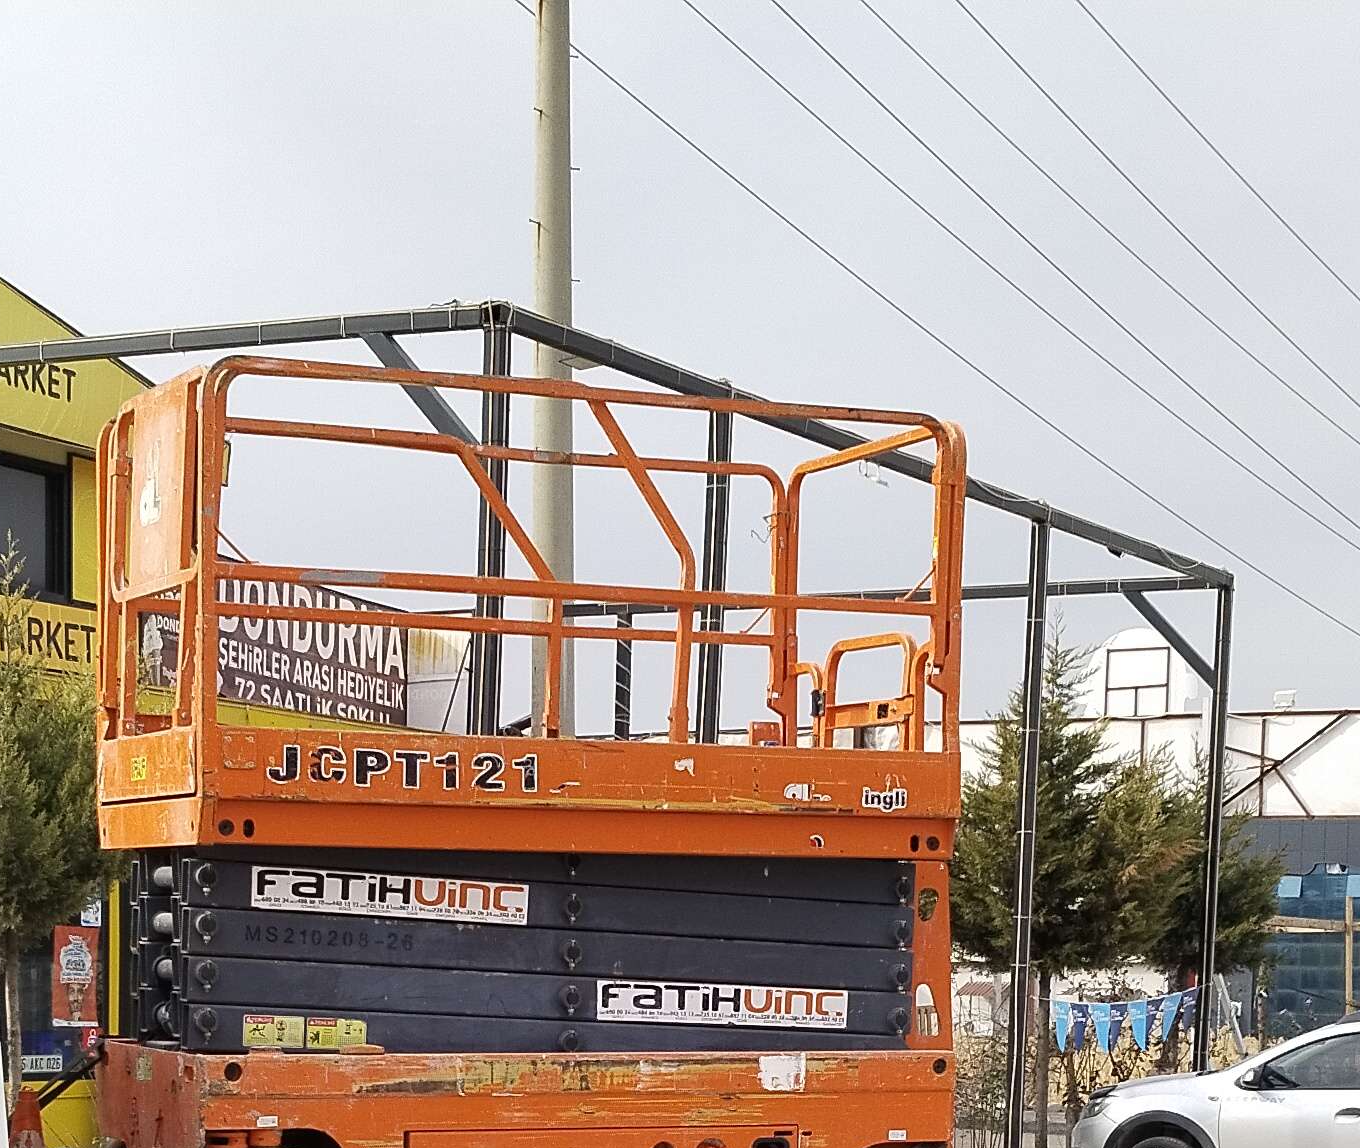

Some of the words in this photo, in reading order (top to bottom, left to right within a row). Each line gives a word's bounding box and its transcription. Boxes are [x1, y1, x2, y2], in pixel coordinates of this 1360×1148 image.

[218, 578, 407, 680] DONDURMA
[234, 676, 256, 701] 72
[292, 657, 334, 694] ARASI
